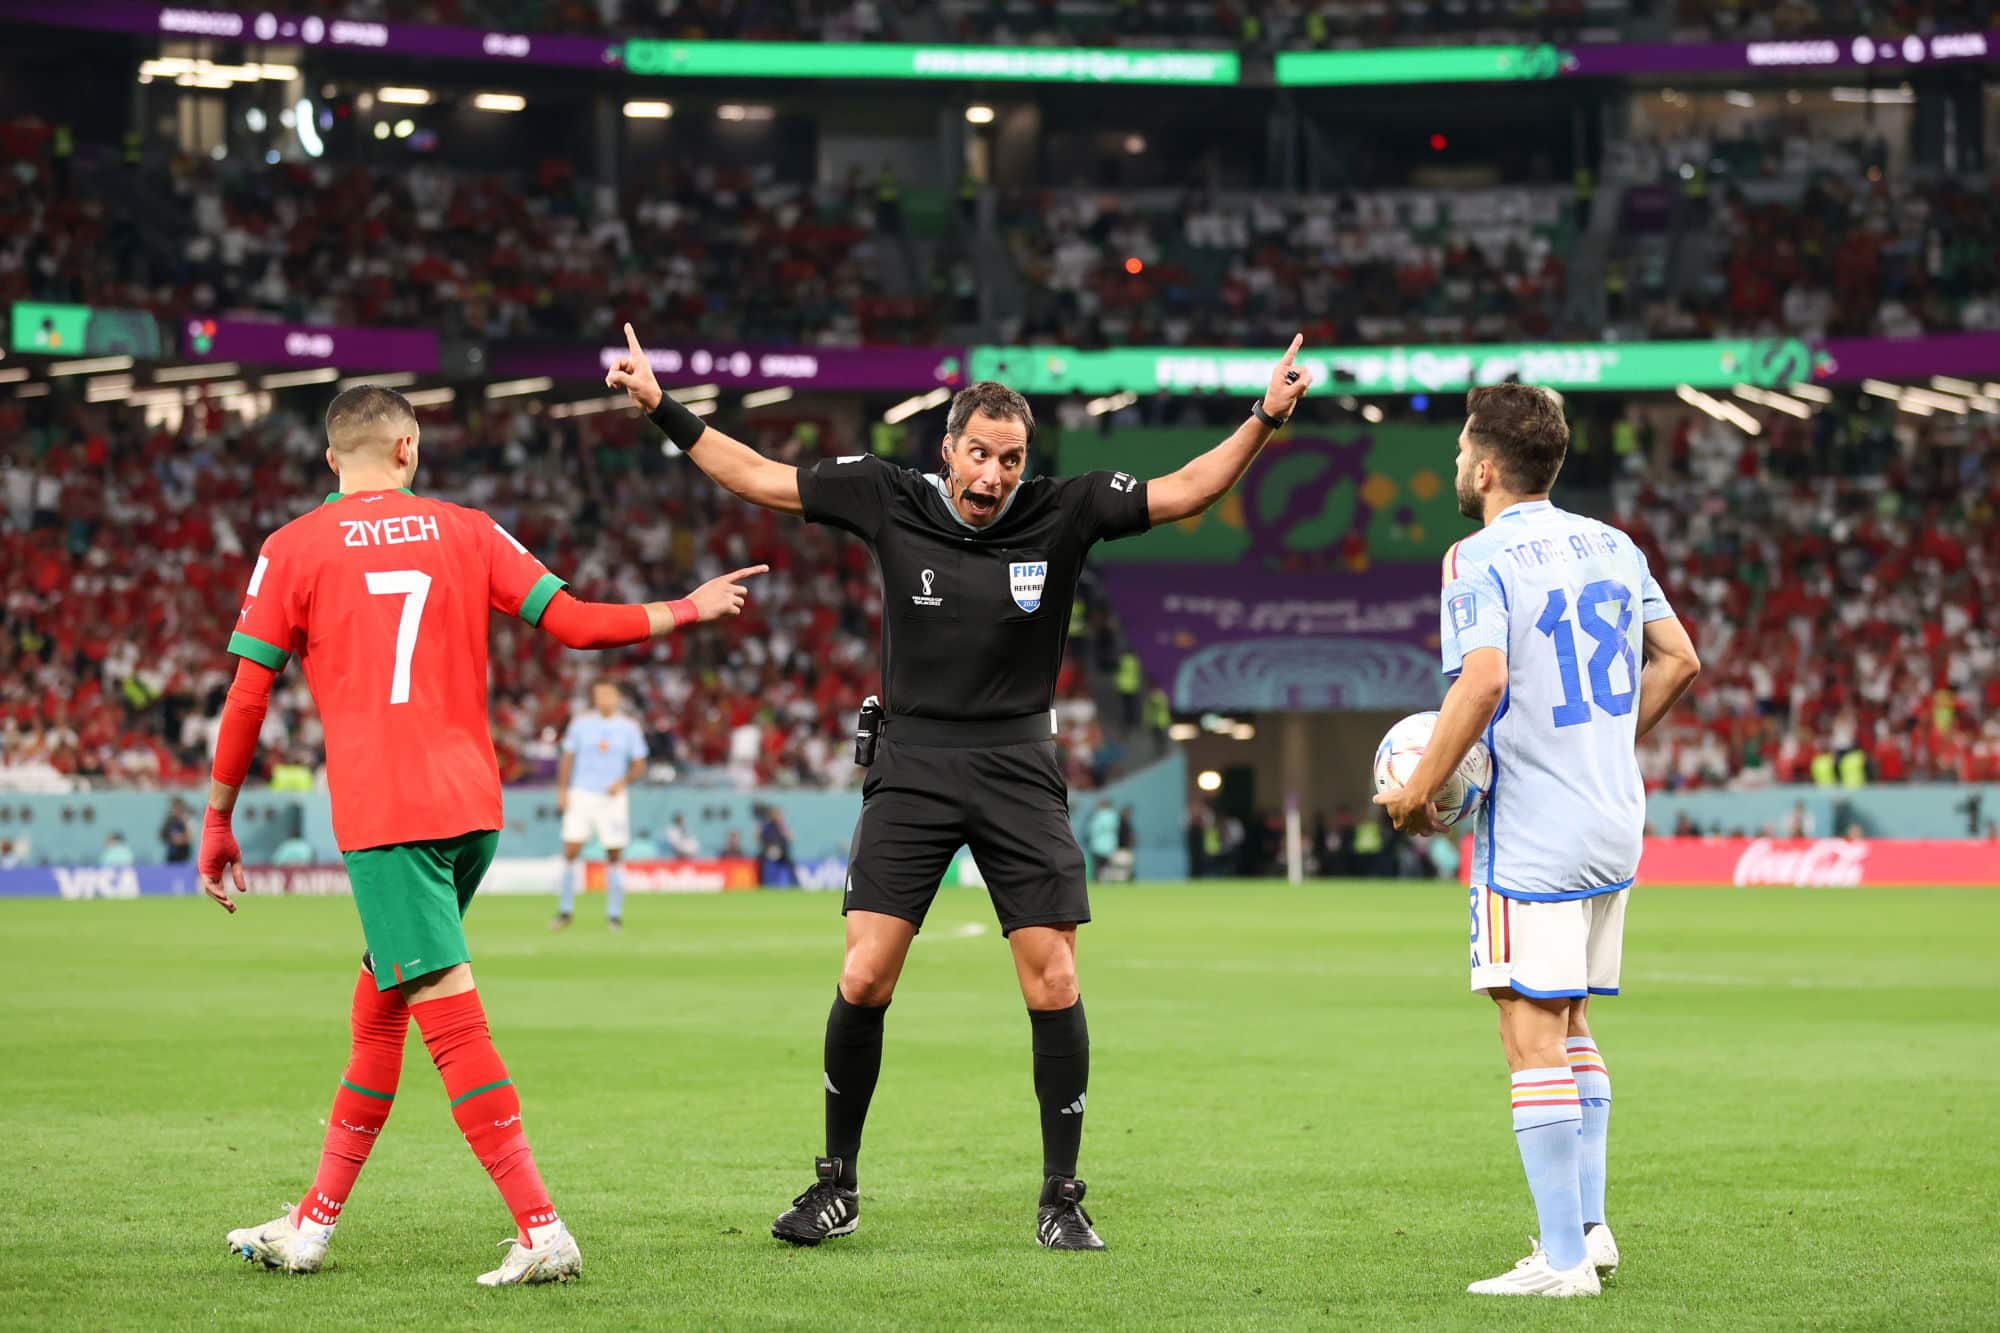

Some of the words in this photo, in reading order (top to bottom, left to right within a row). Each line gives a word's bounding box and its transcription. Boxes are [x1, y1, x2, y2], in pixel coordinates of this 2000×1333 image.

[339, 515, 440, 547] ZIYECH
[1013, 564, 1045, 578] FIFA
[364, 569, 433, 705] 7
[1535, 579, 1637, 729] 18
[55, 867, 141, 898] VISA
